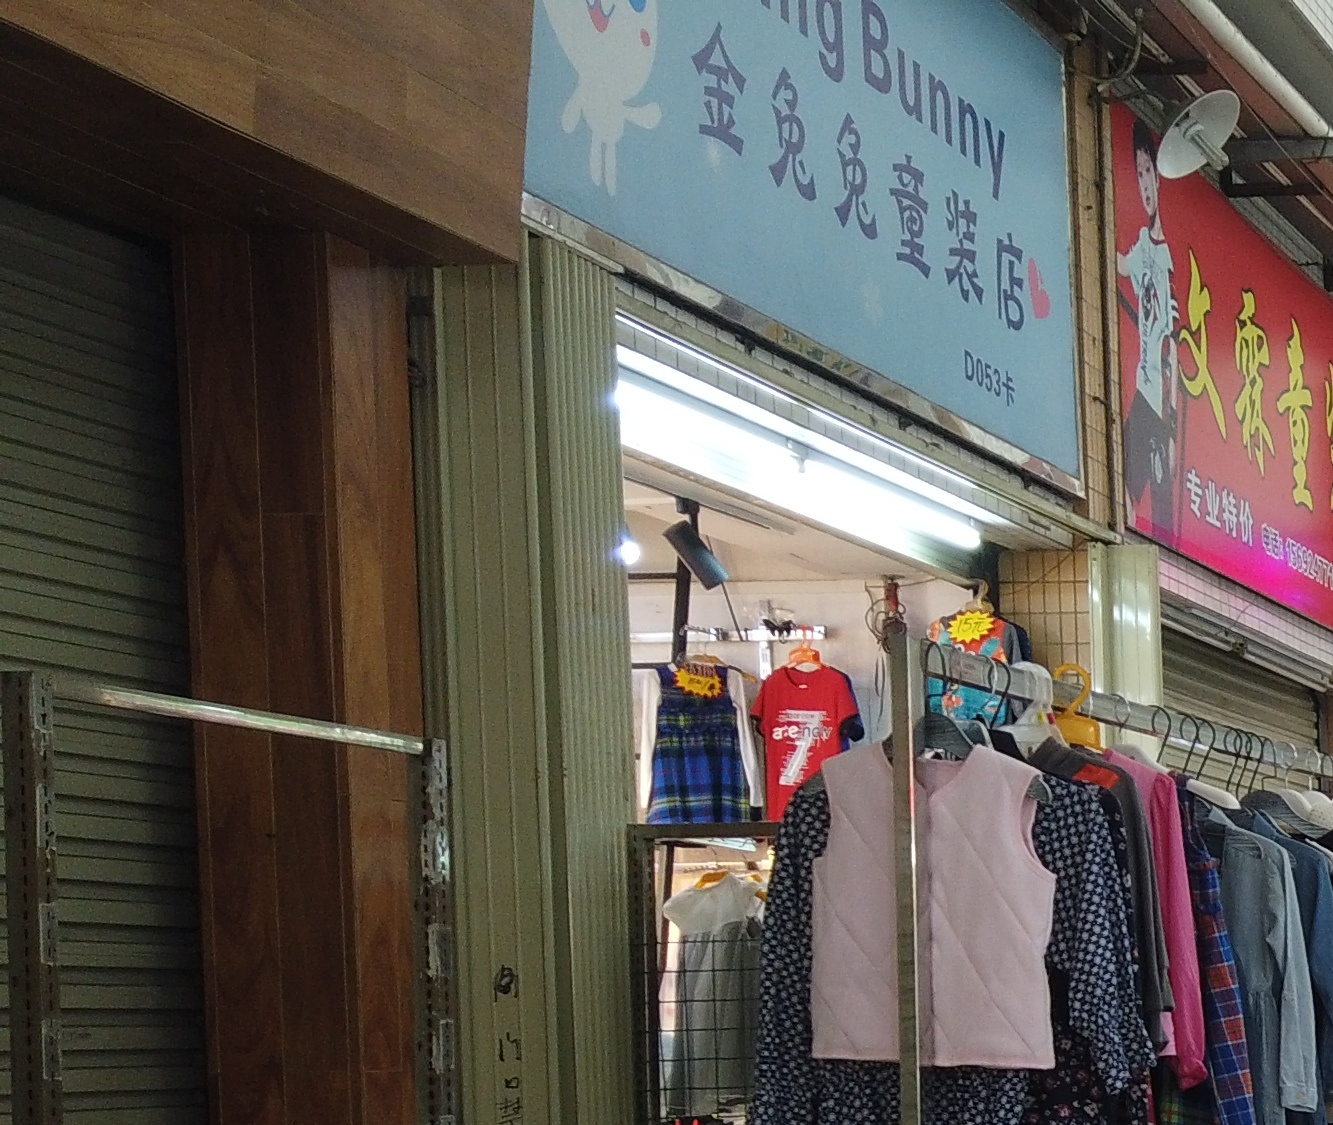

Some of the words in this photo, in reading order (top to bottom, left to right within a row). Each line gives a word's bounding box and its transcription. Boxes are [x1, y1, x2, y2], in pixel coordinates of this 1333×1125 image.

[861, 0, 1006, 200] Bunny
[692, 23, 1025, 331] 金兔兔童装店
[963, 349, 1016, 406] D053卡
[1186, 468, 1254, 547] 专业特价
